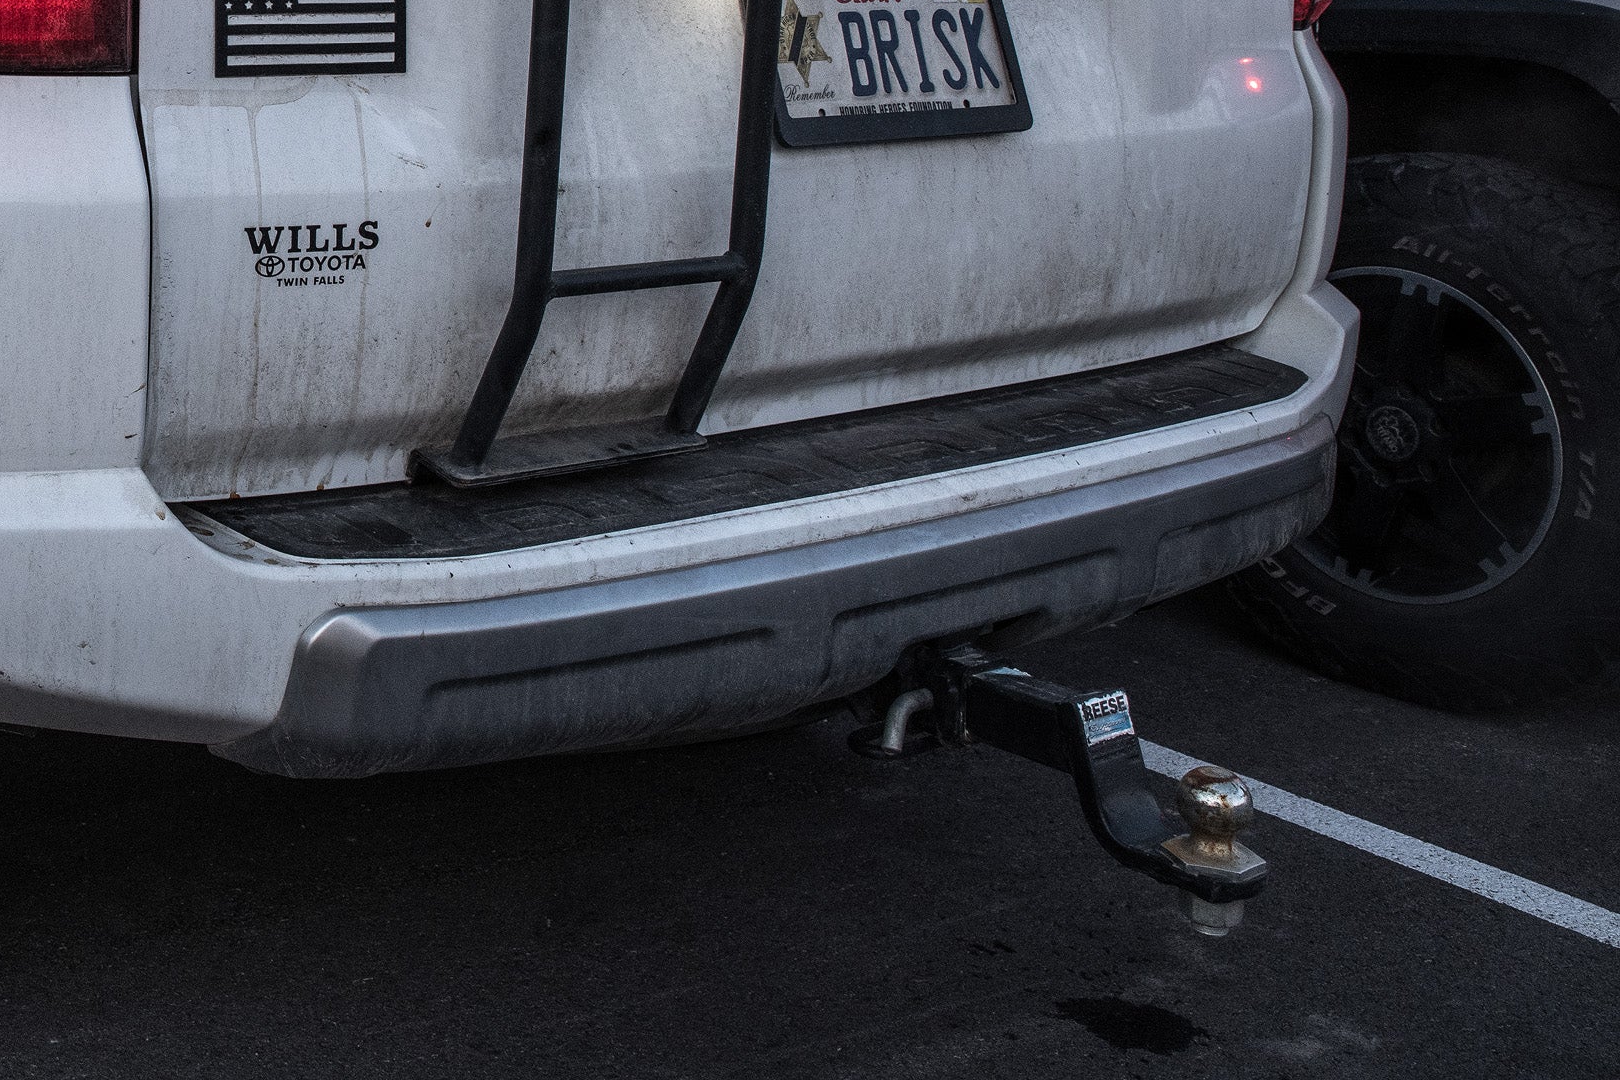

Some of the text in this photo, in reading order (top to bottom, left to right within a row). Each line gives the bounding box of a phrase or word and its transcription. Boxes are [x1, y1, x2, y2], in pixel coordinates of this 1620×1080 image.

[837, 7, 1001, 97] BRISK
[783, 83, 836, 102] Remember
[244, 220, 379, 254] WILLS
[287, 254, 366, 272] TOYOTA
[277, 275, 345, 287] TWIN FALLS
[1573, 451, 1597, 521] T/A
[1082, 695, 1128, 722] REESE
